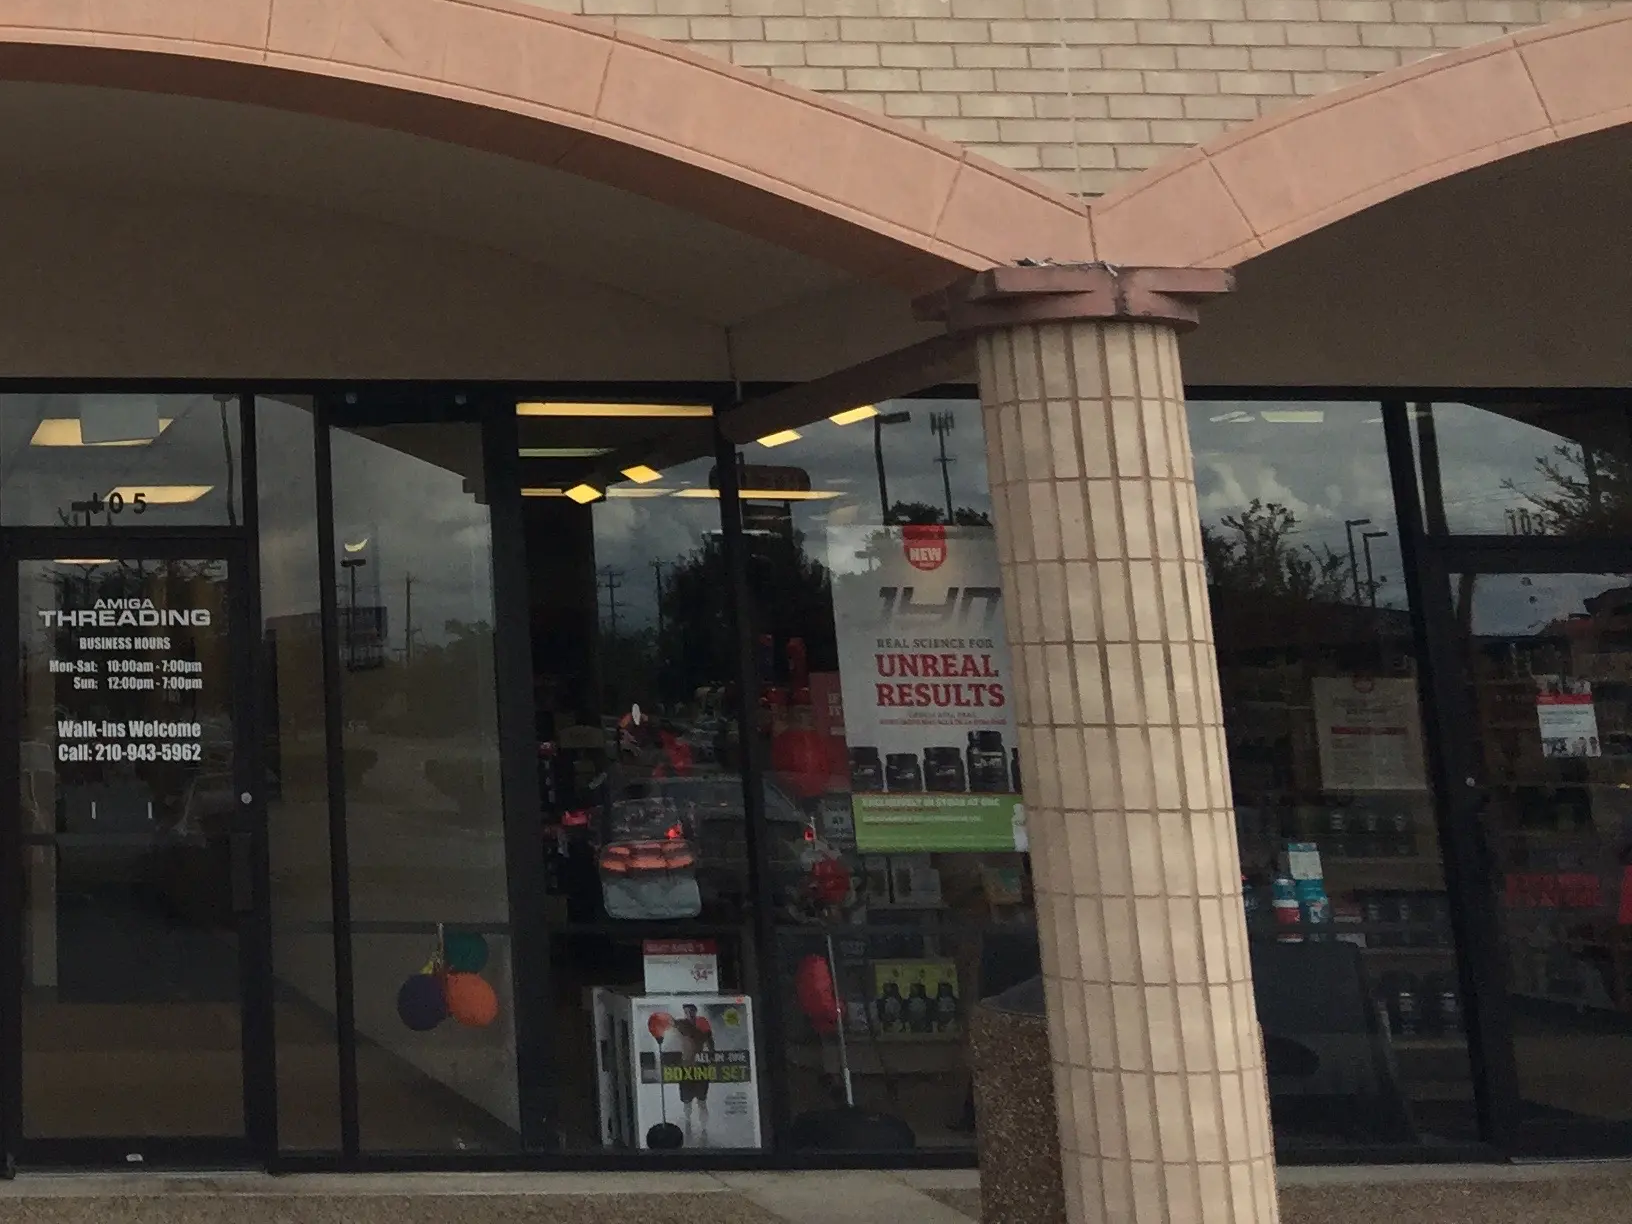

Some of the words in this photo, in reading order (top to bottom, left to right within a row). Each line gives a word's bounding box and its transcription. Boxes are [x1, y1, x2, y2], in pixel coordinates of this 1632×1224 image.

[909, 546, 943, 563] NEW
[94, 598, 155, 610] AMIGA
[39, 609, 212, 627] THREADING
[79, 637, 132, 650] BUSINESS
[134, 637, 171, 650] HOURS
[876, 638, 910, 649] REAL
[913, 638, 967, 649] SCIENCE
[969, 638, 995, 649] FOR
[49, 659, 99, 673] Mon-Sat:
[106, 659, 154, 673] 10:00am
[161, 659, 203, 674] 7:00pm
[874, 653, 1000, 678] UNREAL
[73, 676, 99, 690] Sun:
[107, 676, 155, 691] 12:00pm
[162, 676, 203, 691] 7:00pm
[875, 683, 1006, 708] RESULTS
[128, 720, 202, 738] Welcome
[58, 743, 93, 761] Call:
[95, 743, 202, 761] 210-943-5962
[663, 1065, 717, 1081] BOXING
[720, 1065, 747, 1080] SET
